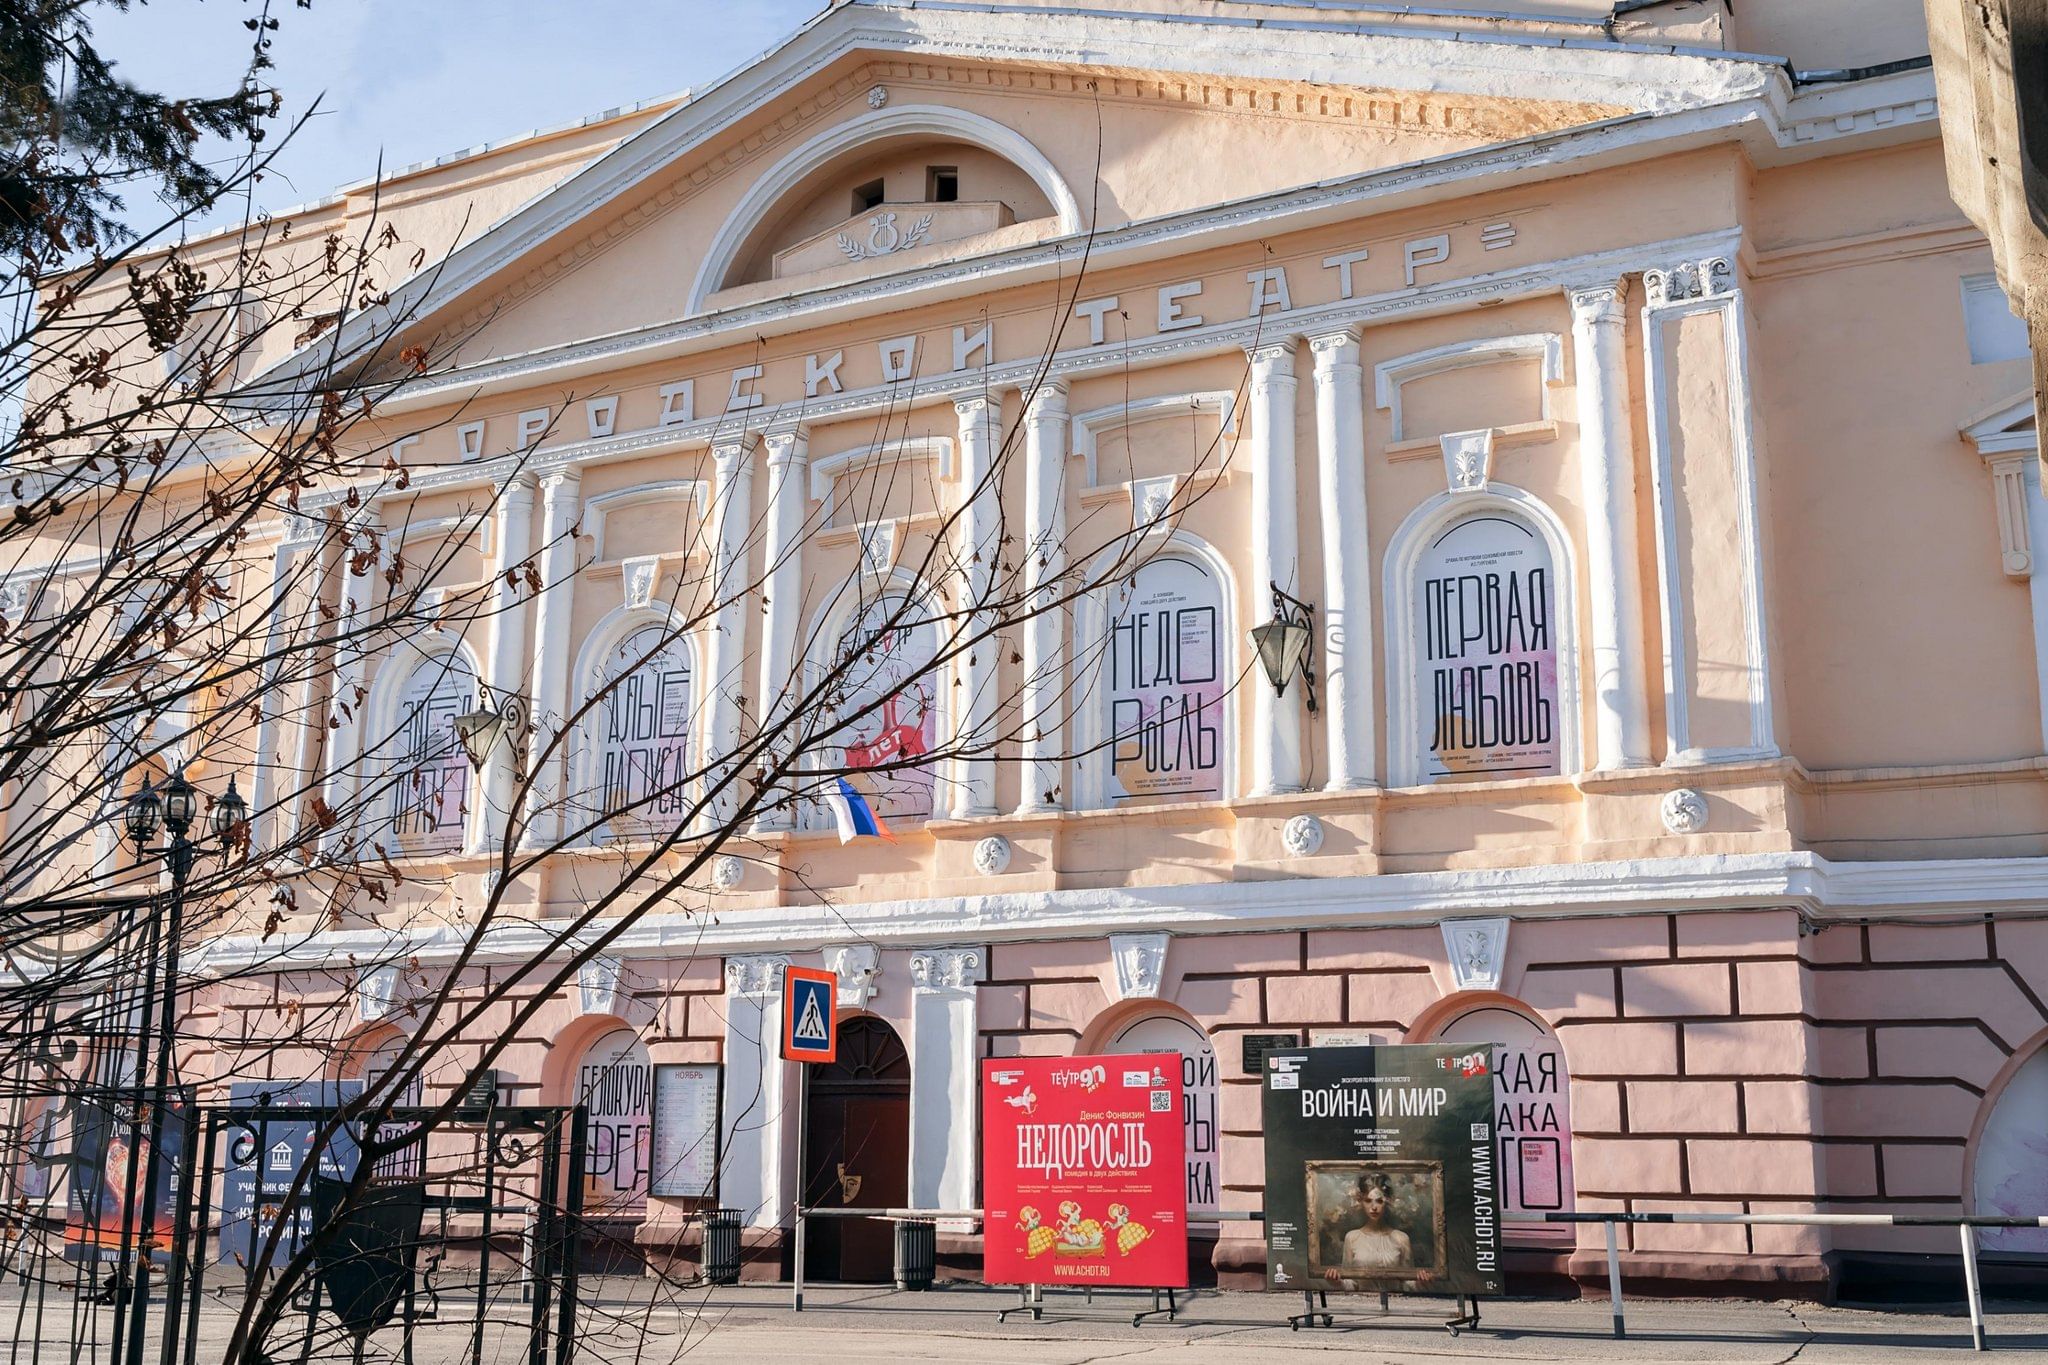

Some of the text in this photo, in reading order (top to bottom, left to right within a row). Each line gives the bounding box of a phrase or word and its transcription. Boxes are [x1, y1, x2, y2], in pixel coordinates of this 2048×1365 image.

[1076, 234, 1451, 346] ТЕАТР
[1425, 568, 1548, 661] ПЕРВАЯ
[1112, 606, 1216, 691] НЕДО
[608, 670, 691, 744] АЛЫЕ
[1430, 660, 1551, 752] ЛЮБОВЬ
[869, 729, 902, 762] лет
[1111, 692, 1217, 776] РОСЛЬ
[674, 1070, 704, 1080] НОЯБРЬ
[1462, 1051, 1486, 1070] 90
[1079, 1109, 1145, 1120] Денис Фонвизин
[1301, 1085, 1447, 1118] ВОЙНА И МИР
[1016, 1122, 1152, 1180] НЕДОРОСЛЬ
[238, 1182, 277, 1192] УЧАСНИК
[1093, 1170, 1107, 1178] двух
[1107, 1169, 1138, 1178] действиях
[1471, 1146, 1496, 1273] WWW.ACHDT.RU
[1053, 1264, 1111, 1277] WWW.ACHDT.RU
[1486, 1280, 1498, 1290] 12+
